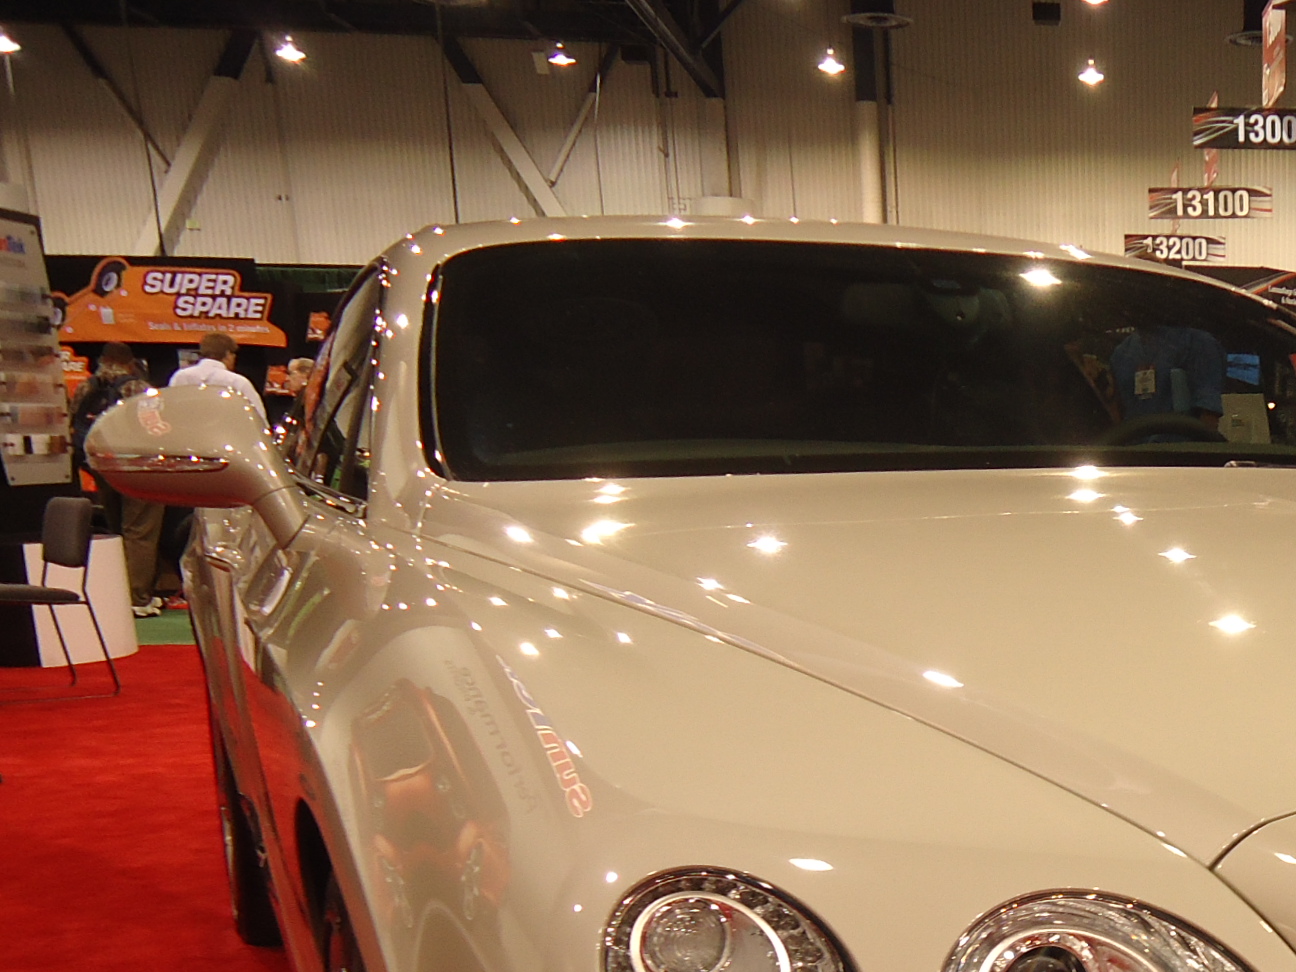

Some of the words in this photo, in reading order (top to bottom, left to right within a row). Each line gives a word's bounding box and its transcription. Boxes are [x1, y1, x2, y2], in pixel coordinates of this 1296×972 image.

[1172, 190, 1250, 217] 13100
[1143, 236, 1208, 260] 13200
[143, 271, 236, 296] SUPER
[174, 295, 267, 319] SPARE
